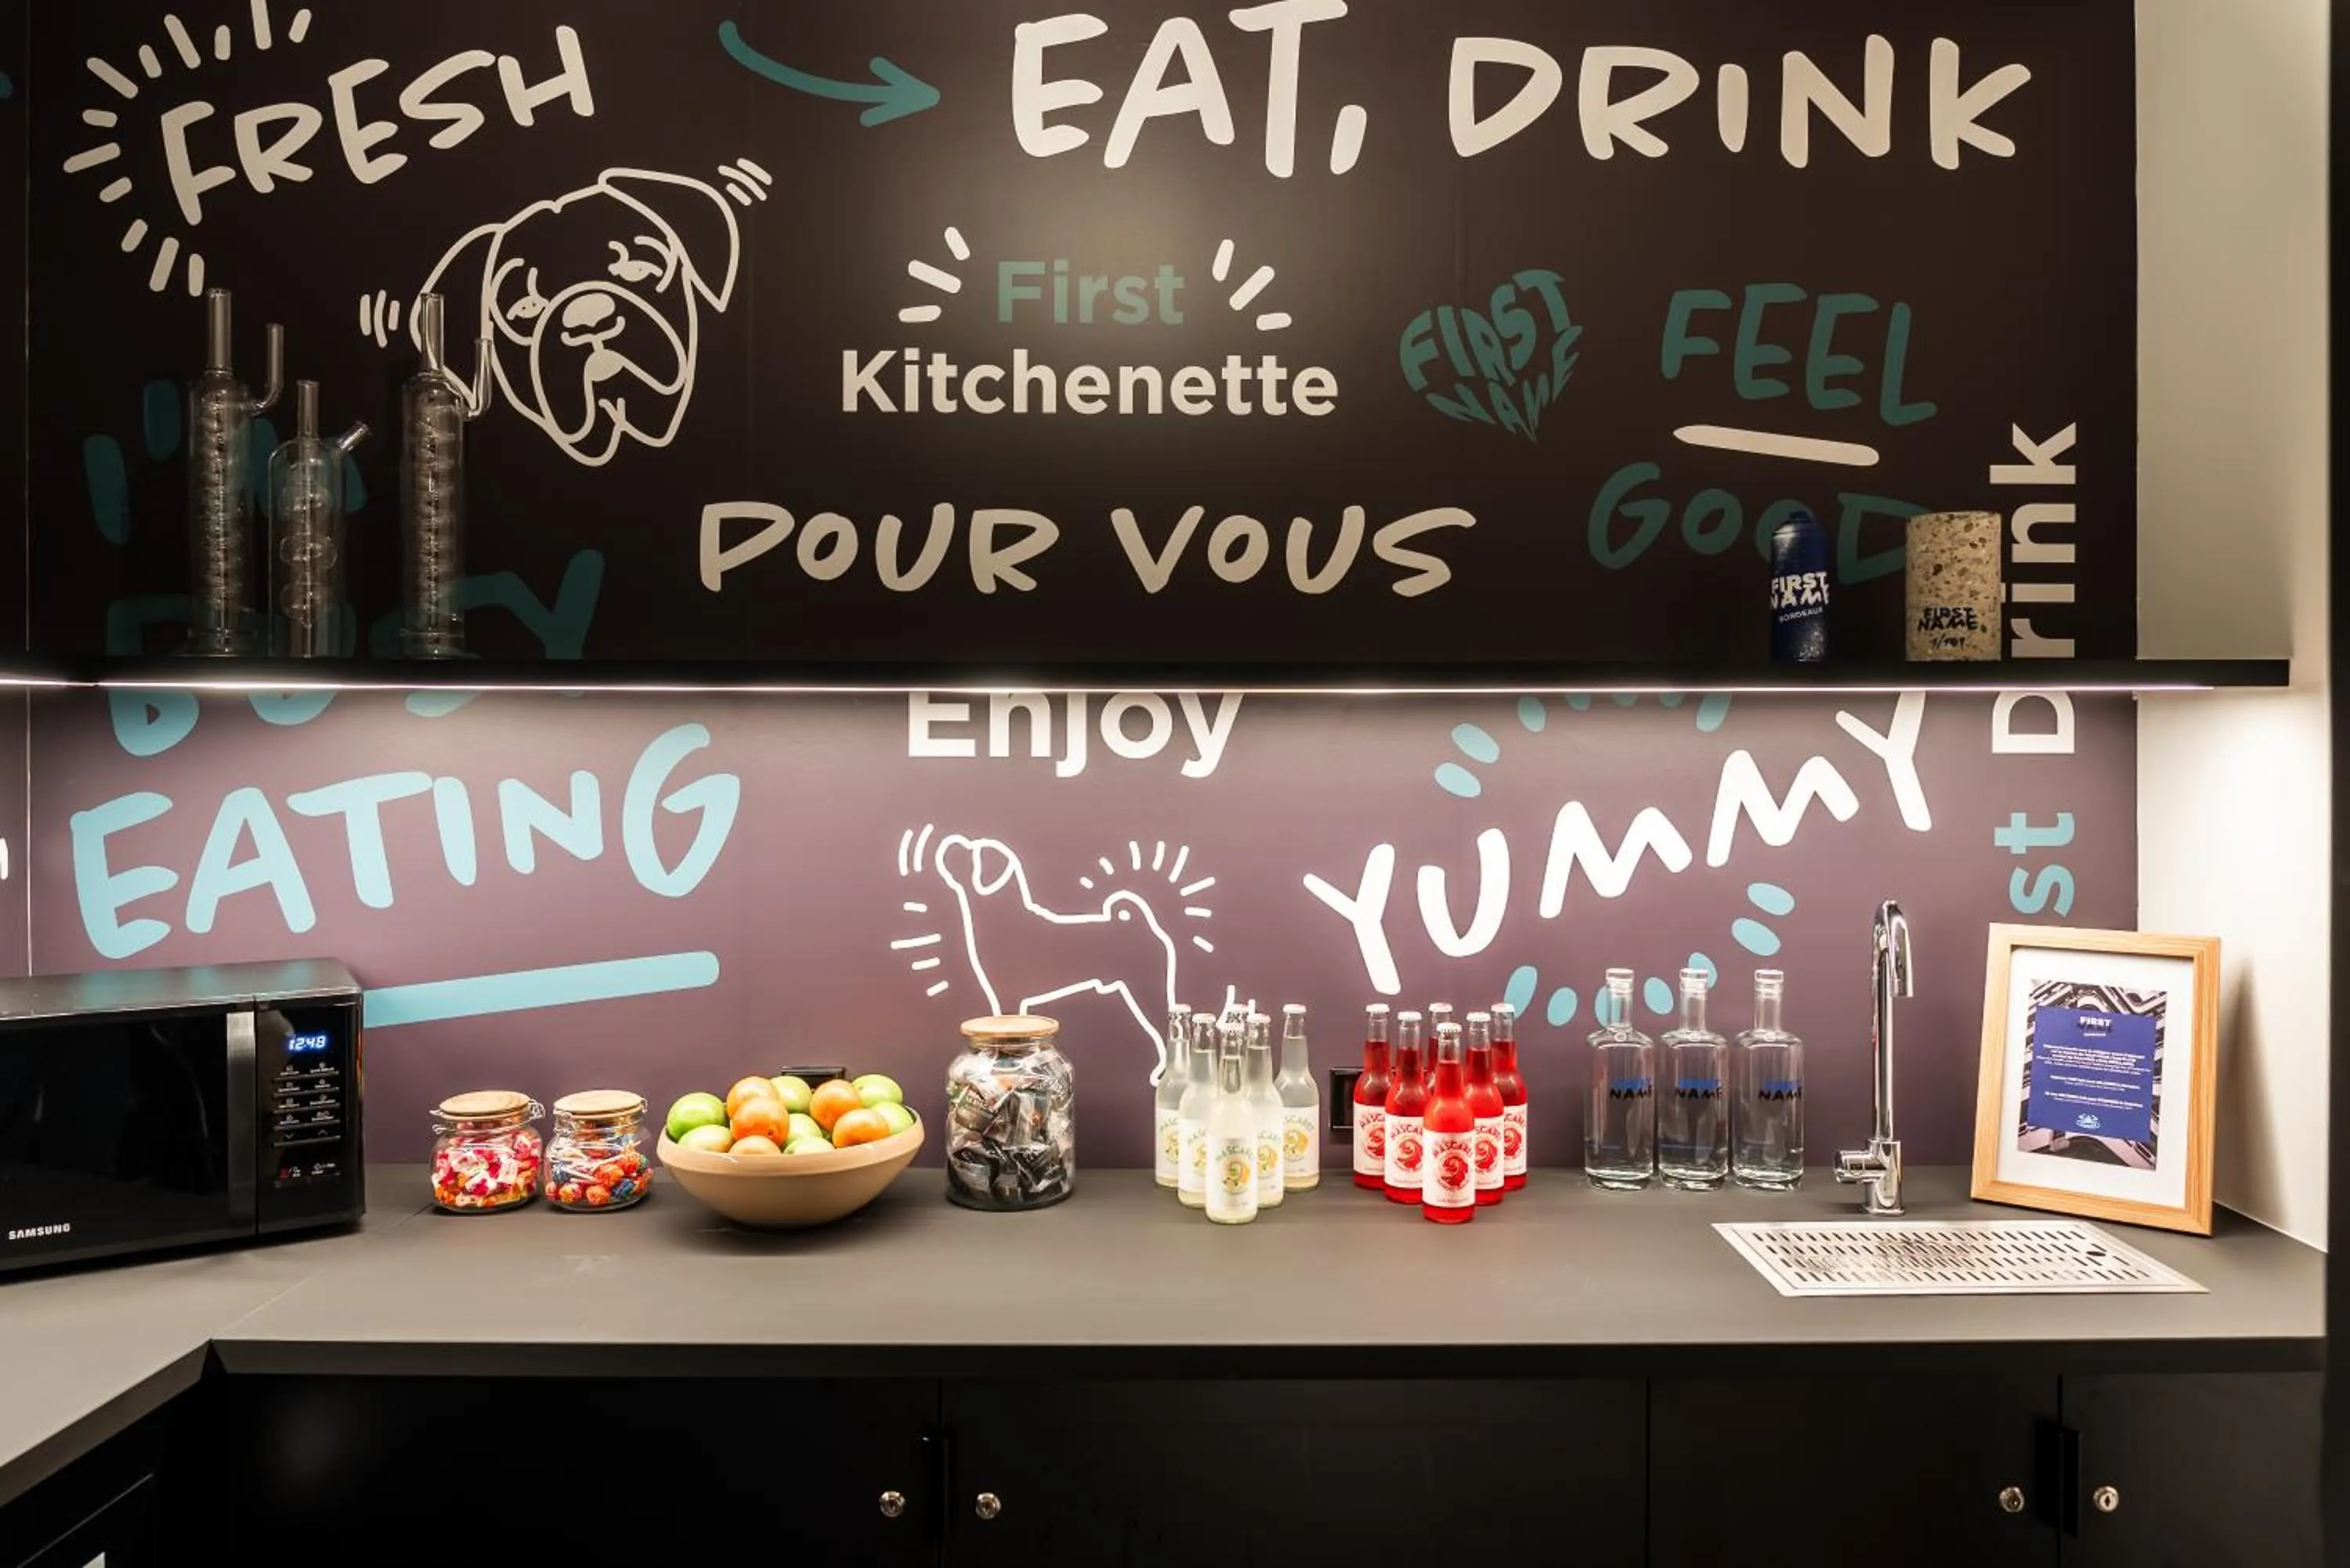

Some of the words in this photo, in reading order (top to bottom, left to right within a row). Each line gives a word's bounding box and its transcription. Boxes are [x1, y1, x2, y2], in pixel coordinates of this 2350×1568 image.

[160, 25, 595, 226] FRESH
[1011, 0, 1367, 178] EAT,
[1448, 34, 2032, 170] DRINK
[997, 259, 1186, 324] First
[1400, 269, 1571, 392] FIRST
[842, 349, 1339, 416] Kitchenette
[1426, 324, 1584, 444] NAME
[1660, 283, 1938, 427] FEEL
[700, 500, 1060, 594] POUR
[1110, 504, 1477, 598] VOUS
[1770, 571, 1828, 594] FIRST
[907, 691, 1244, 779] Enjoy
[70, 723, 741, 959] EATING
[1303, 690, 1932, 995] YUMMY
[9, 1223, 71, 1240] SAMSUNG
